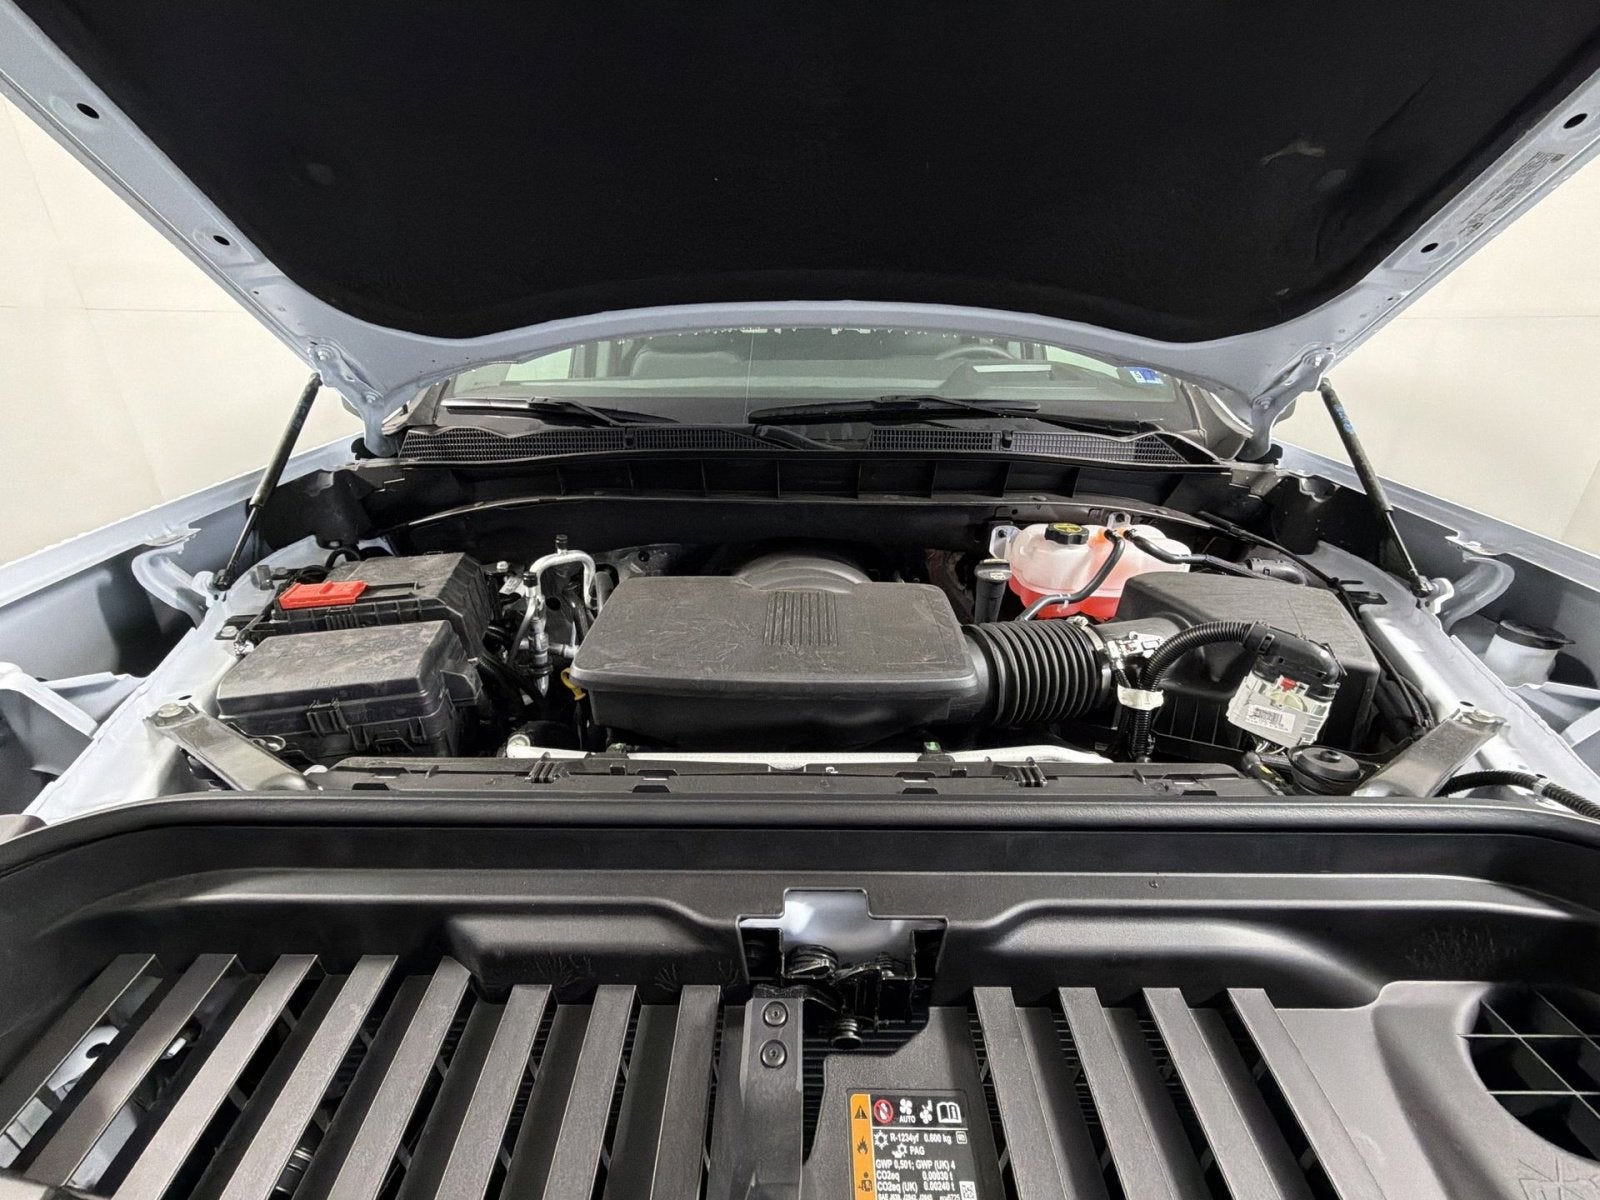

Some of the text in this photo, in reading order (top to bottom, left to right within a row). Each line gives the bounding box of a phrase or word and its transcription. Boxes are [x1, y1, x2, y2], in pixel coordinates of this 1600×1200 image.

[899, 1115, 916, 1123] AUTO
[942, 1133, 952, 1145] kg
[909, 1145, 925, 1155] PAG
[875, 1159, 893, 1169] GWP
[915, 1160, 933, 1169] GWP
[934, 1160, 950, 1171] (UK)
[950, 1160, 956, 1169] 4
[876, 1170, 900, 1182] CO2eq
[877, 1181, 901, 1193] CO2eq
[902, 1181, 918, 1193] (UK)
